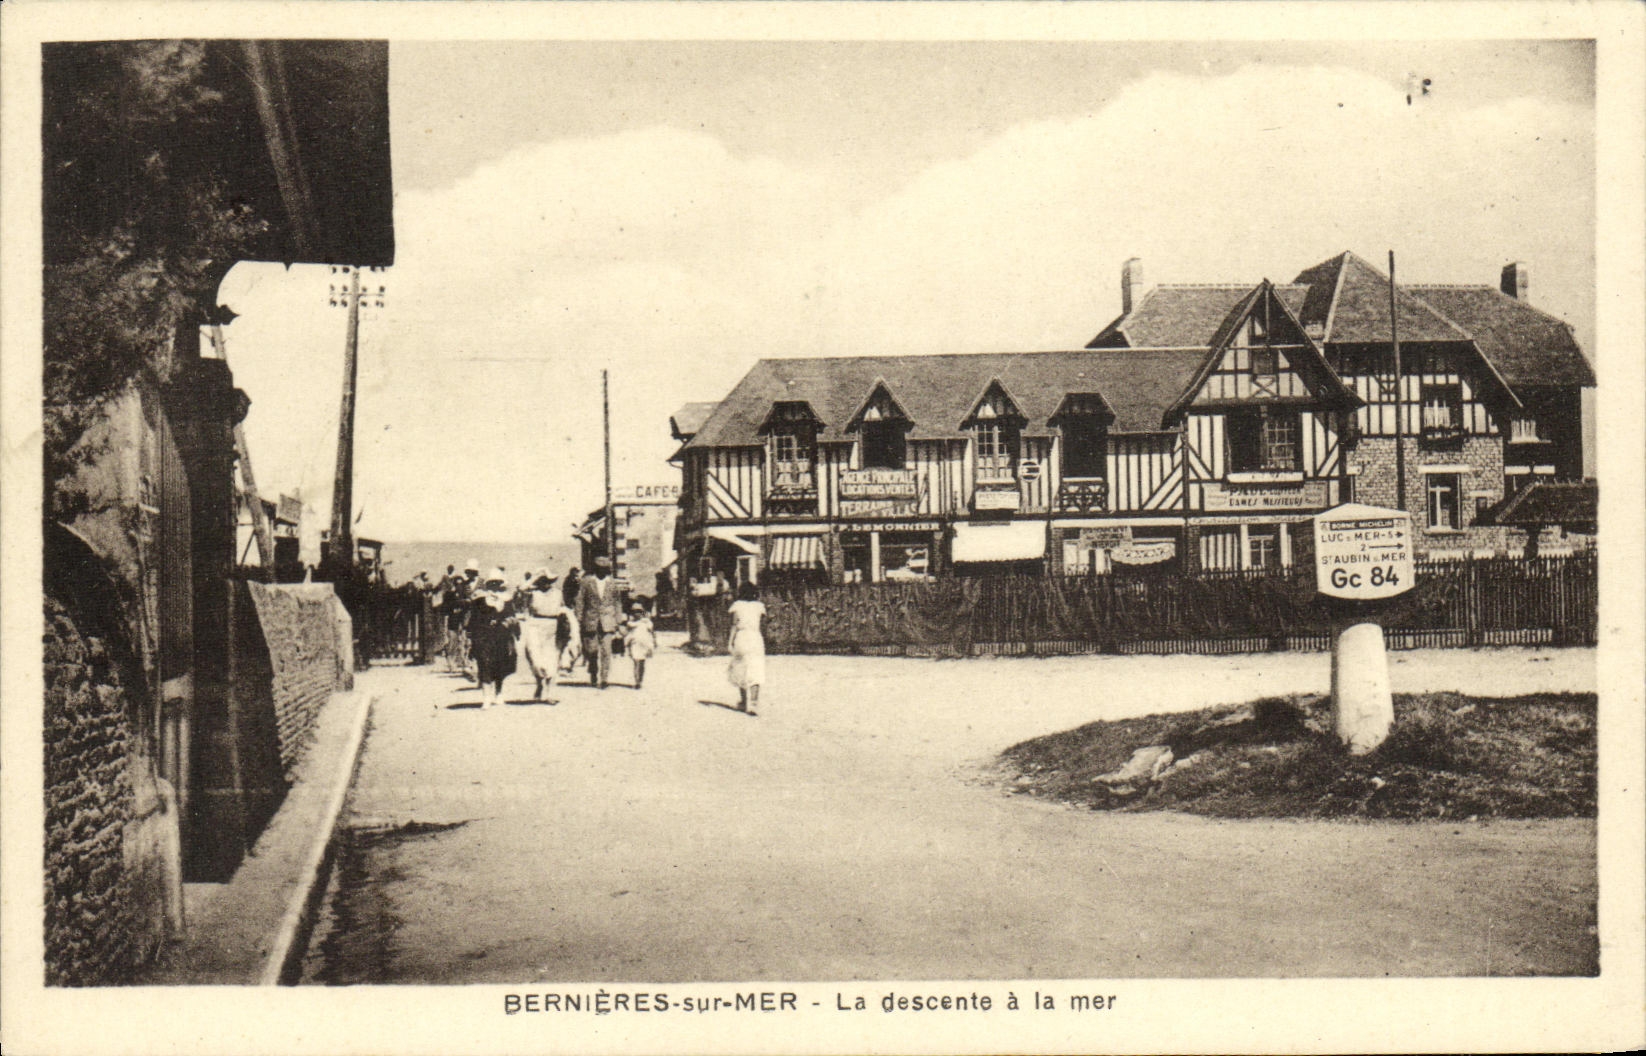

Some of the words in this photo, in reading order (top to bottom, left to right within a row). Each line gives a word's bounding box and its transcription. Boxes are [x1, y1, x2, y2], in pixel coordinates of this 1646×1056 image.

[1358, 520, 1393, 529] MICHELIN
[1321, 533, 1344, 543] LUC
[1360, 543, 1366, 552] 2
[1381, 552, 1407, 562] MER
[1331, 568, 1362, 589] Gc
[1370, 565, 1400, 587] 84
